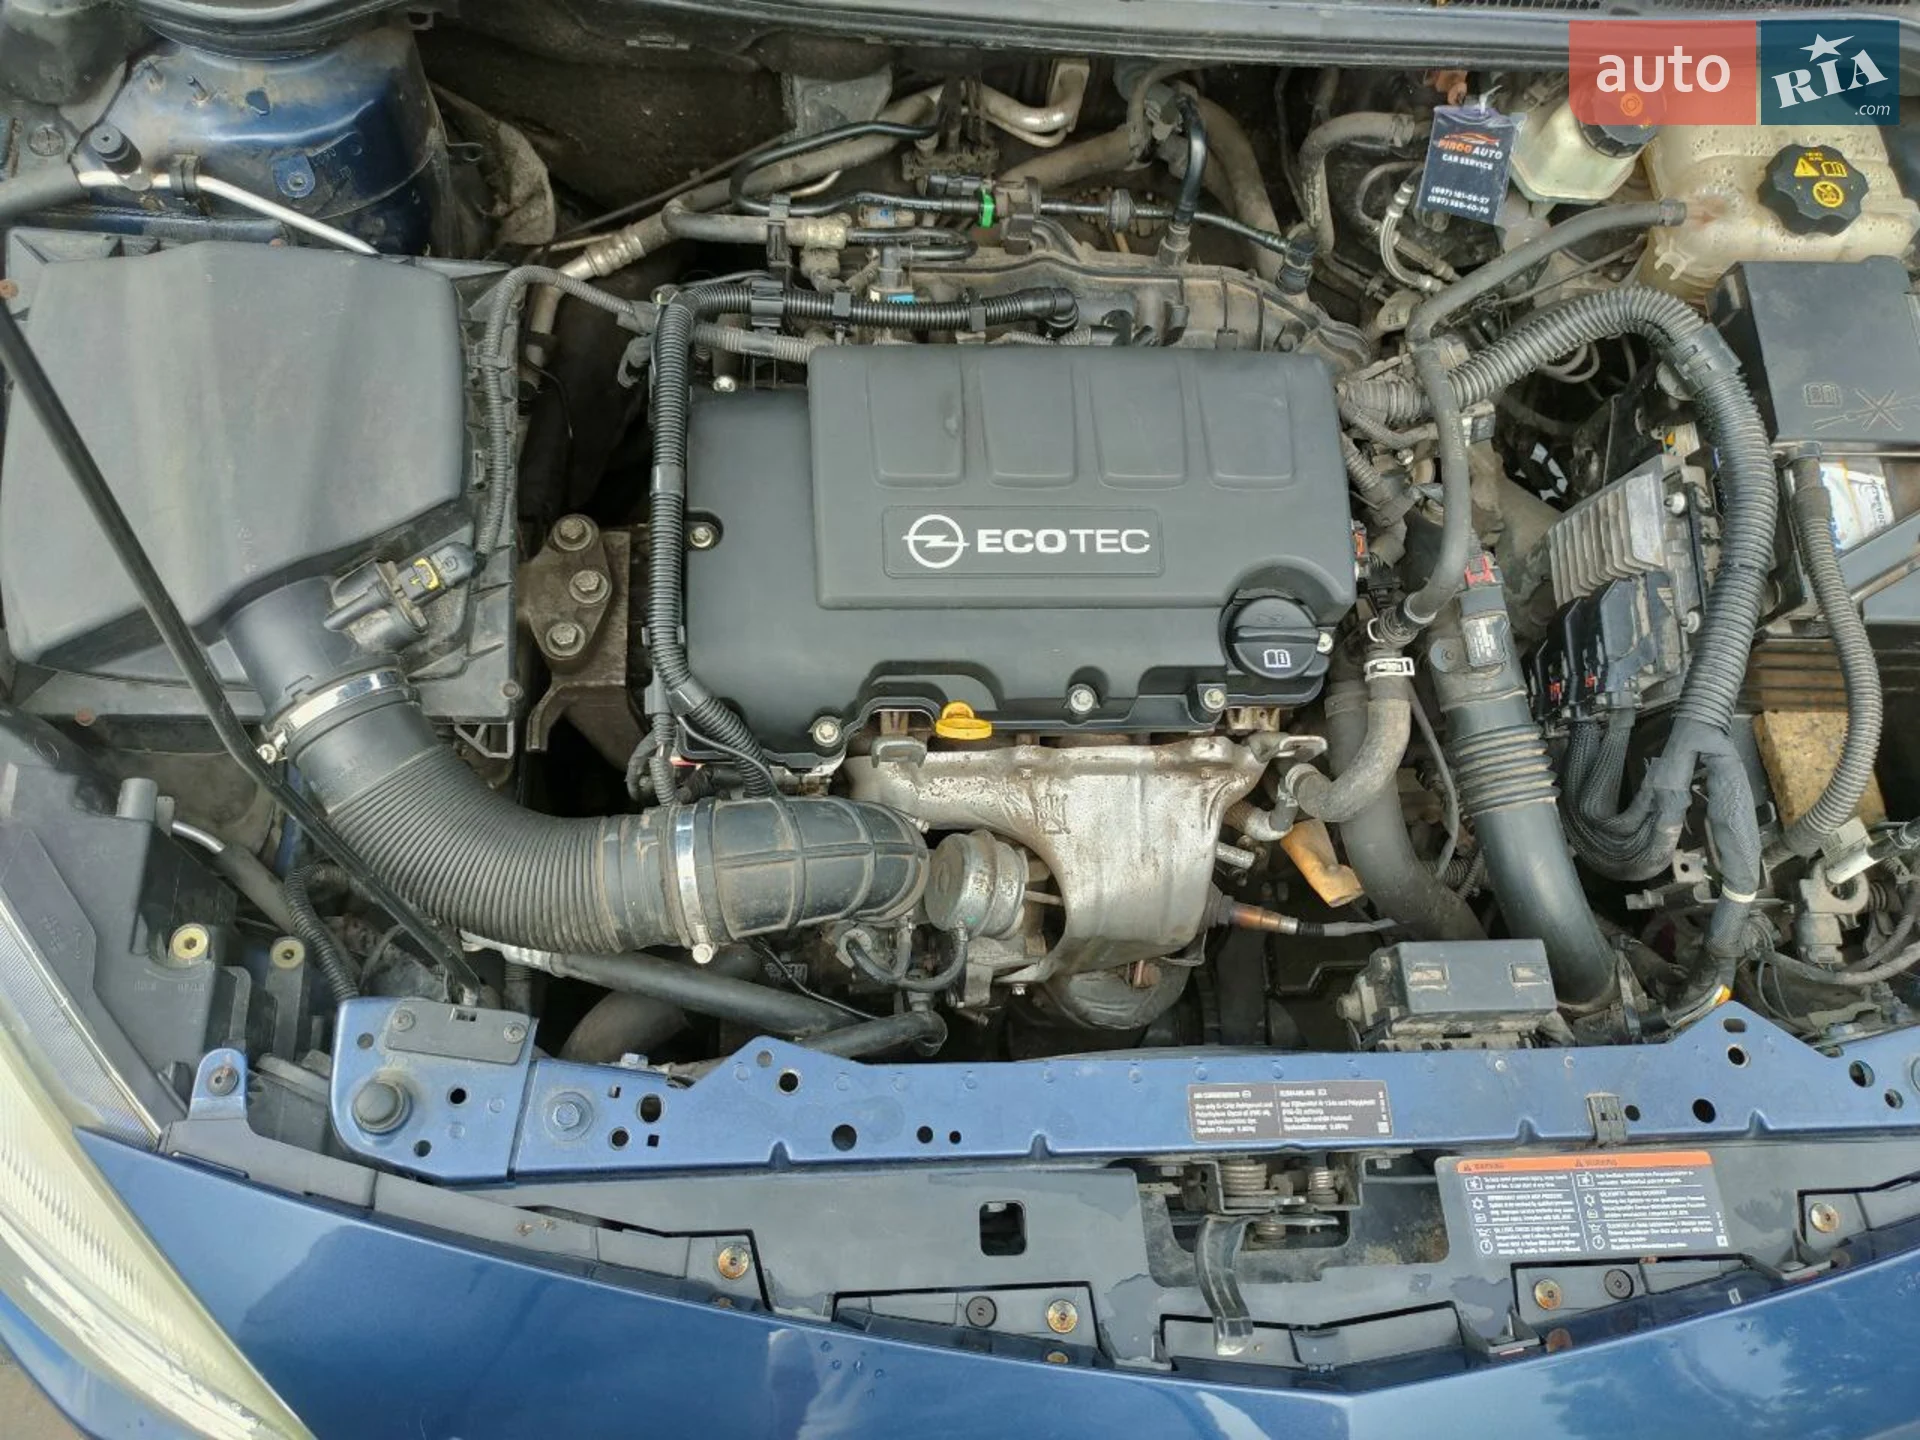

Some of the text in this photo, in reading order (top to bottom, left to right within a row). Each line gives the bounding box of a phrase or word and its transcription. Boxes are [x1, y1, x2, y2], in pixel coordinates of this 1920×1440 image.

[1472, 146, 1503, 160] AUTO
[1443, 154, 1494, 170] CAR SERVICE
[977, 529, 1151, 554] ECOTEC
